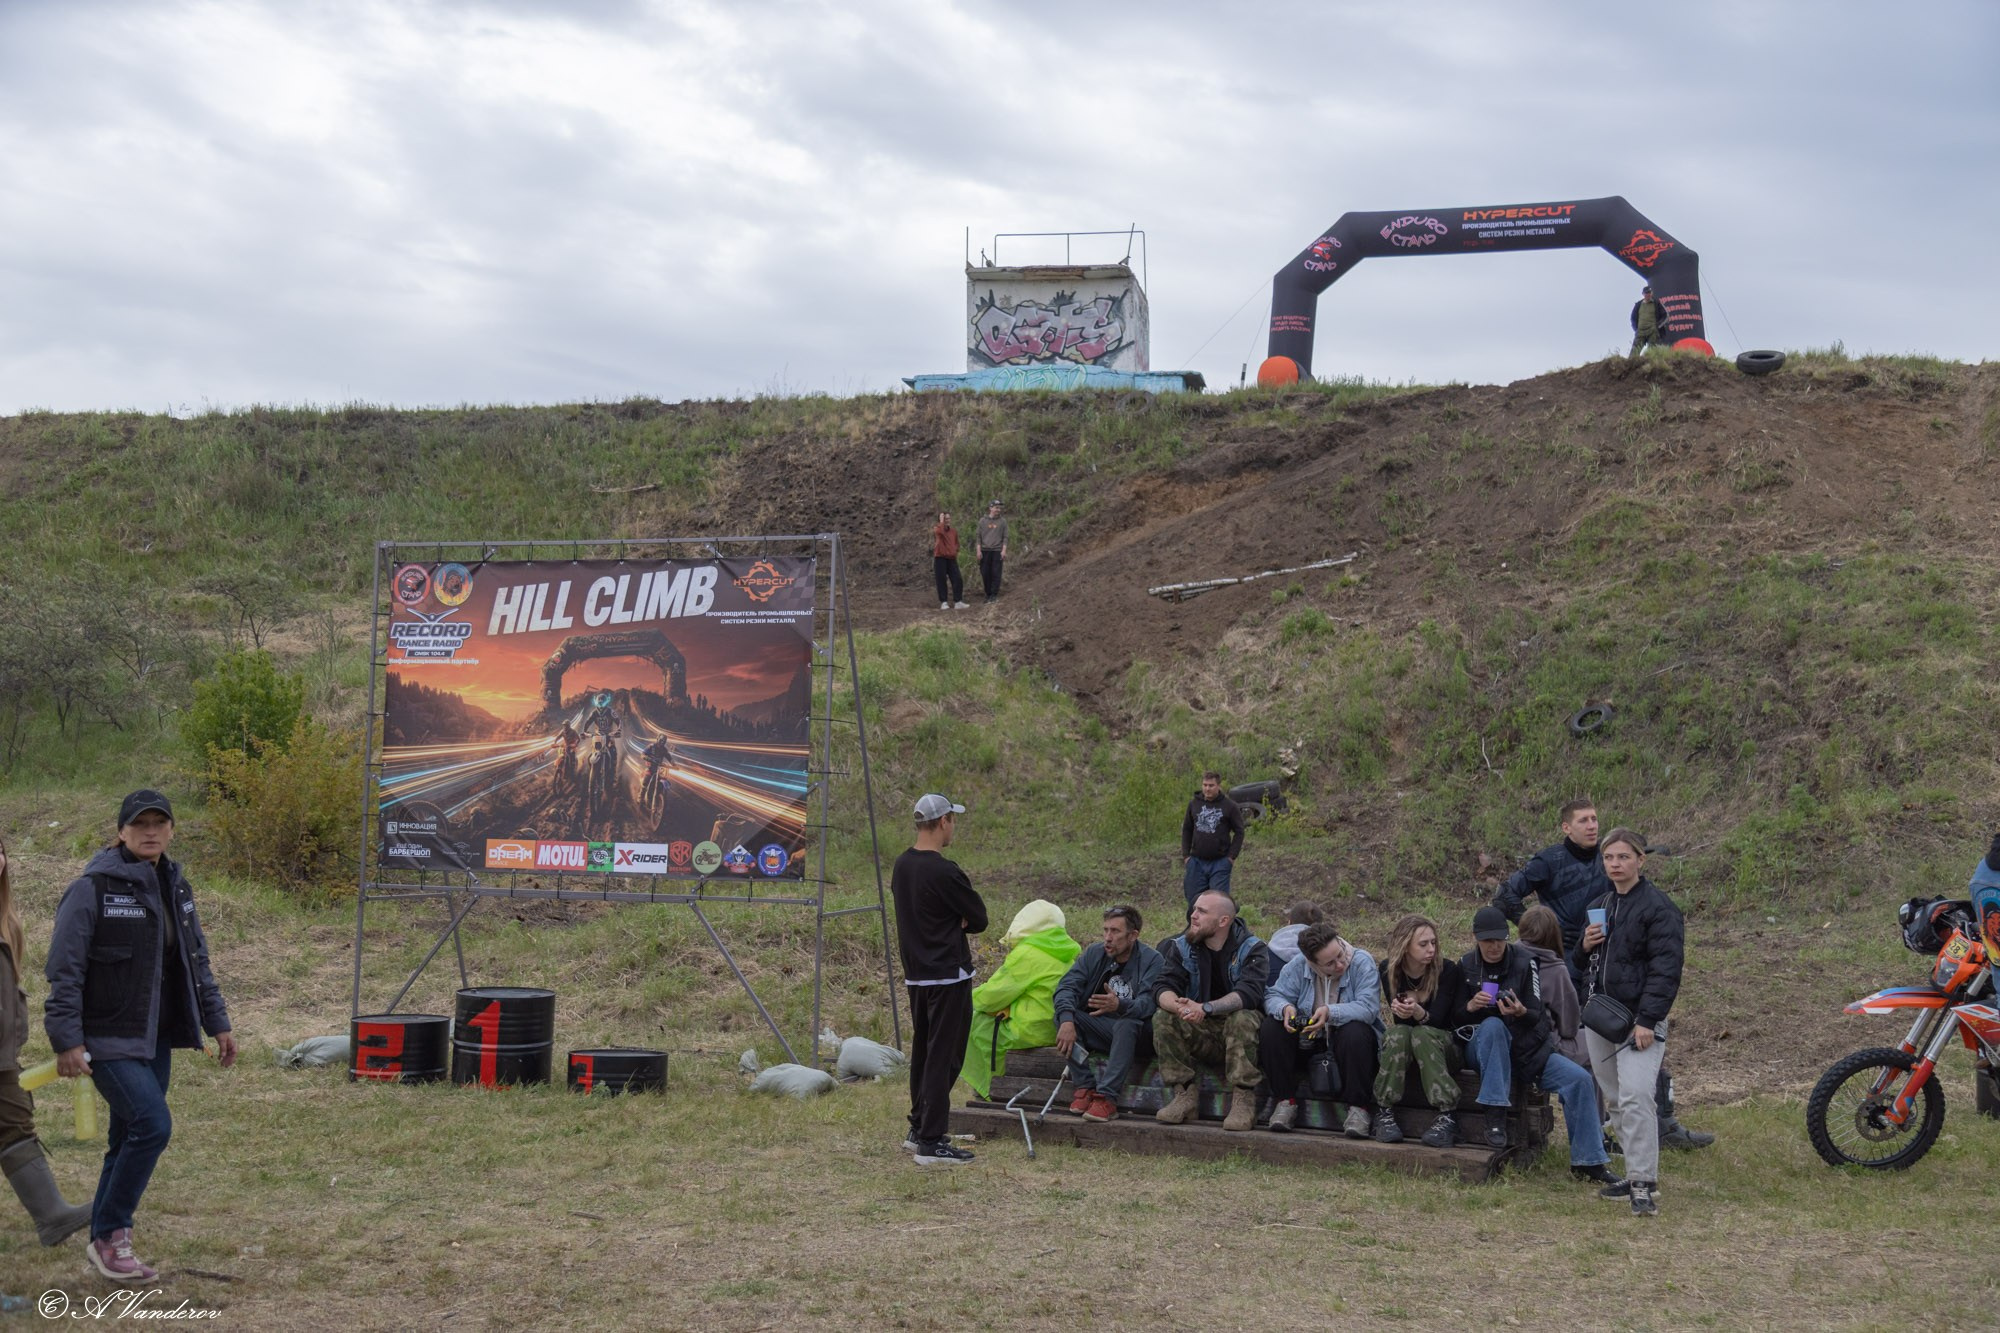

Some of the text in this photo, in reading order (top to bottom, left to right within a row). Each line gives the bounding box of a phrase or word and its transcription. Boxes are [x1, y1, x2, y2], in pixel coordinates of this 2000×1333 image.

[1463, 205, 1576, 220] HYPERCUT
[1380, 216, 1448, 239] ENDURO
[1462, 218, 1571, 229] ПРОИЗВОДИТЕЛЬ ПРОМЫШЛЕННЫХ
[1504, 229, 1525, 237] РЕЗКИ
[1525, 227, 1555, 235] МЕТАЛЛА
[1618, 242, 1674, 257] HYPERCUT
[733, 578, 795, 586] HYPERCUT
[487, 565, 719, 636] HILL CLIMB
[391, 623, 472, 638] RECORD
[397, 639, 463, 648] DANCE RADIO
[399, 822, 437, 830] ИННОВАЦИЯ
[388, 848, 431, 856] БАРБЕРШОП
[537, 844, 586, 867] MOTUL
[107, 908, 144, 916] НИРВАНА
[355, 1022, 405, 1082] 2
[461, 1000, 511, 1091] 1
